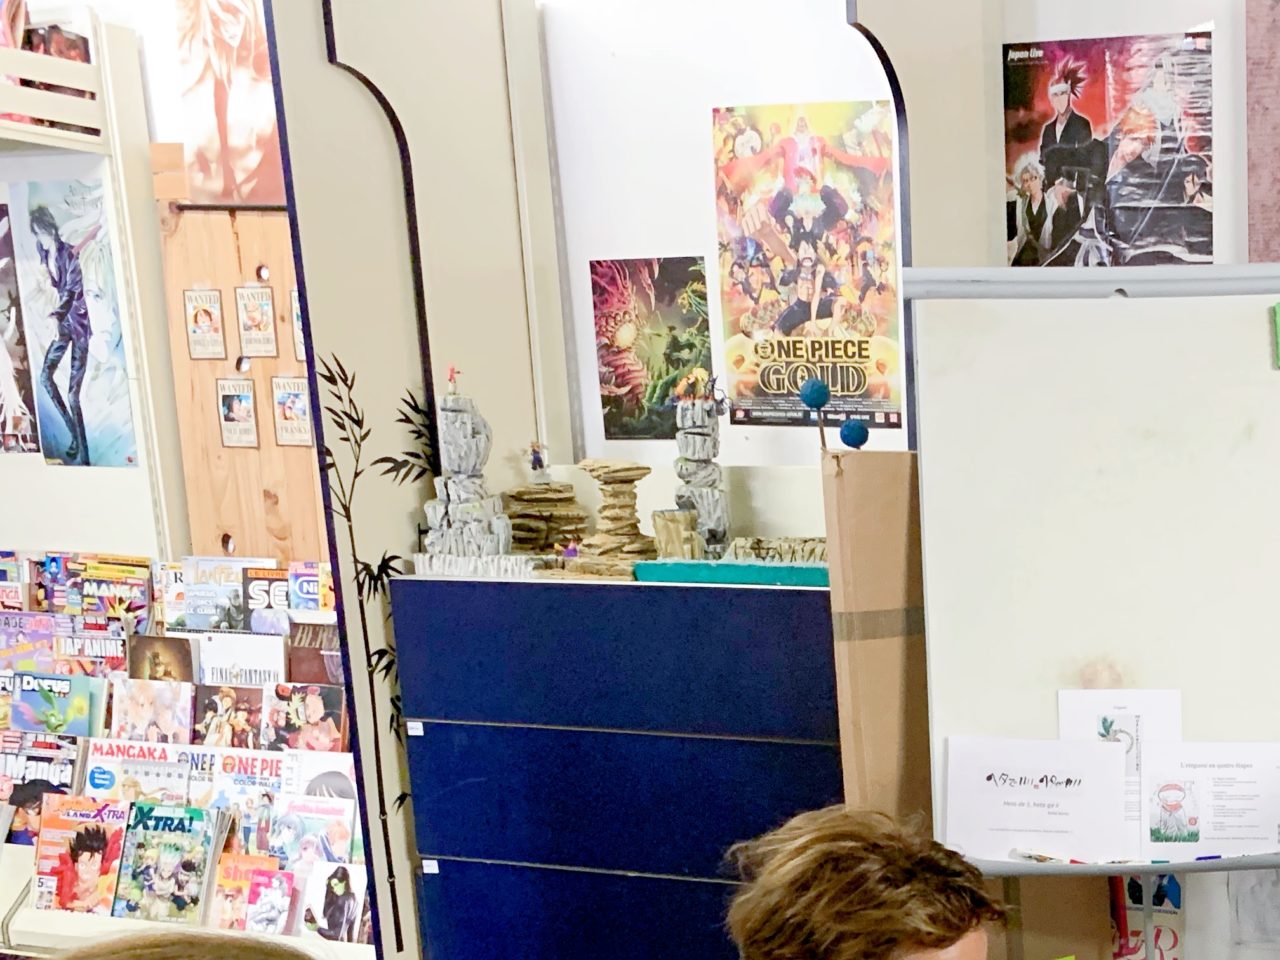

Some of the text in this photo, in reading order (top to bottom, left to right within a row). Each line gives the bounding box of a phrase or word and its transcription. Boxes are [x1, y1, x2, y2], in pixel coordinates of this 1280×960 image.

[1007, 47, 1044, 61] Japan Live
[754, 339, 870, 360] ONE PIECE
[759, 363, 868, 396] GOLD
[91, 742, 168, 761] MANGAKA
